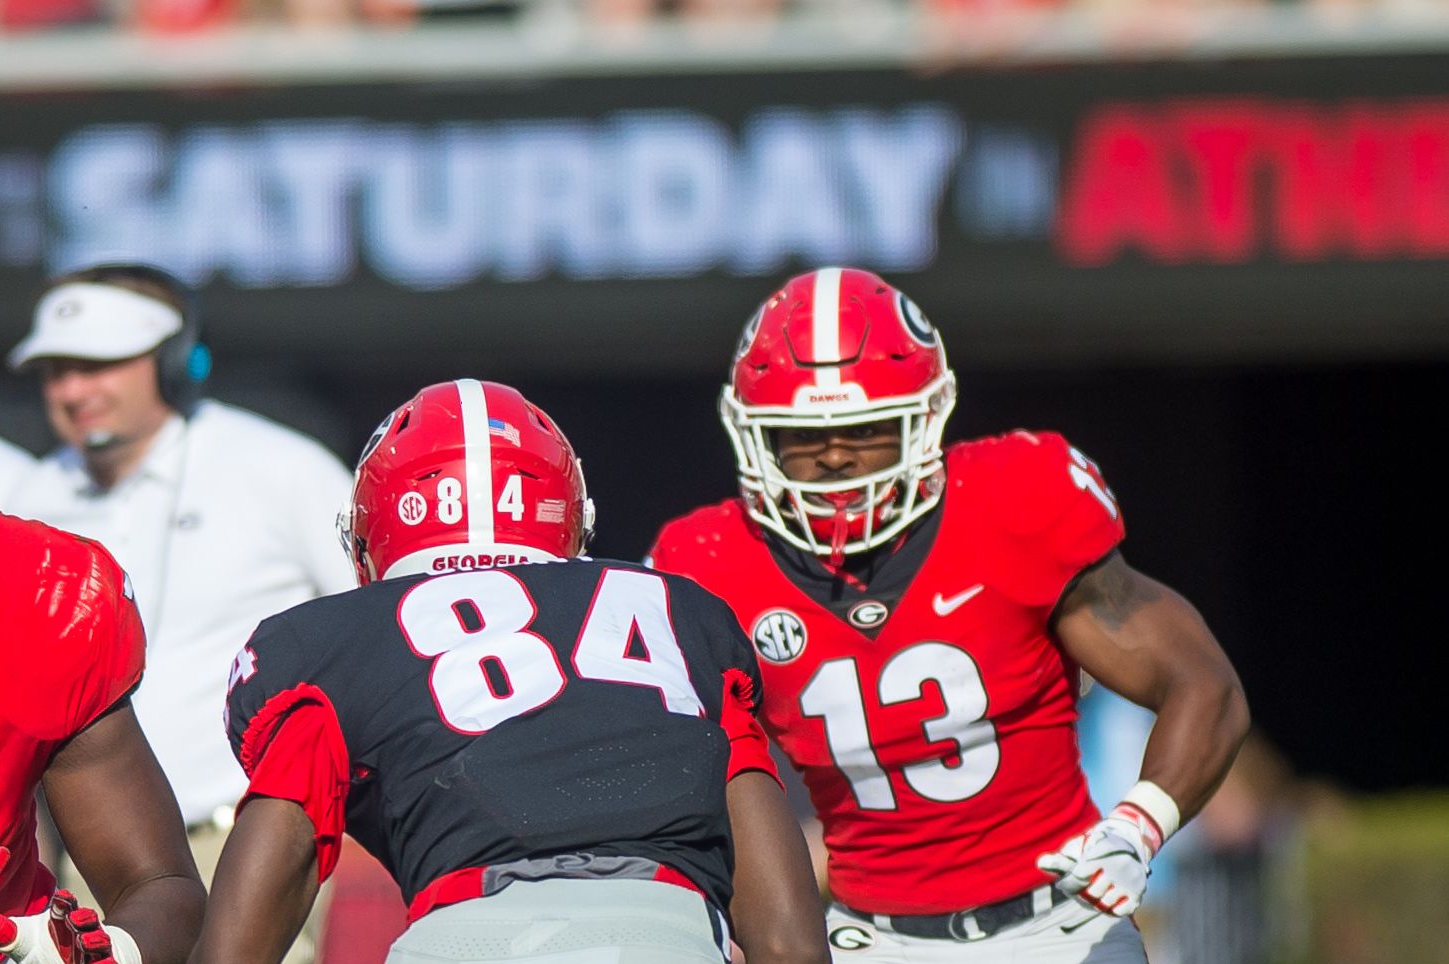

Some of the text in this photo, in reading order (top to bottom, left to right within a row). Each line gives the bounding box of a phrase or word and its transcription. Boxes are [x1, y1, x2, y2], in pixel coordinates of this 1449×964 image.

[49, 112, 963, 292] SATURDAY
[400, 494, 426, 523] SEC
[755, 611, 805, 664] SEC
[851, 604, 888, 627] G
[396, 568, 707, 736] 84
[799, 640, 1001, 811] 13
[829, 926, 875, 950] G
